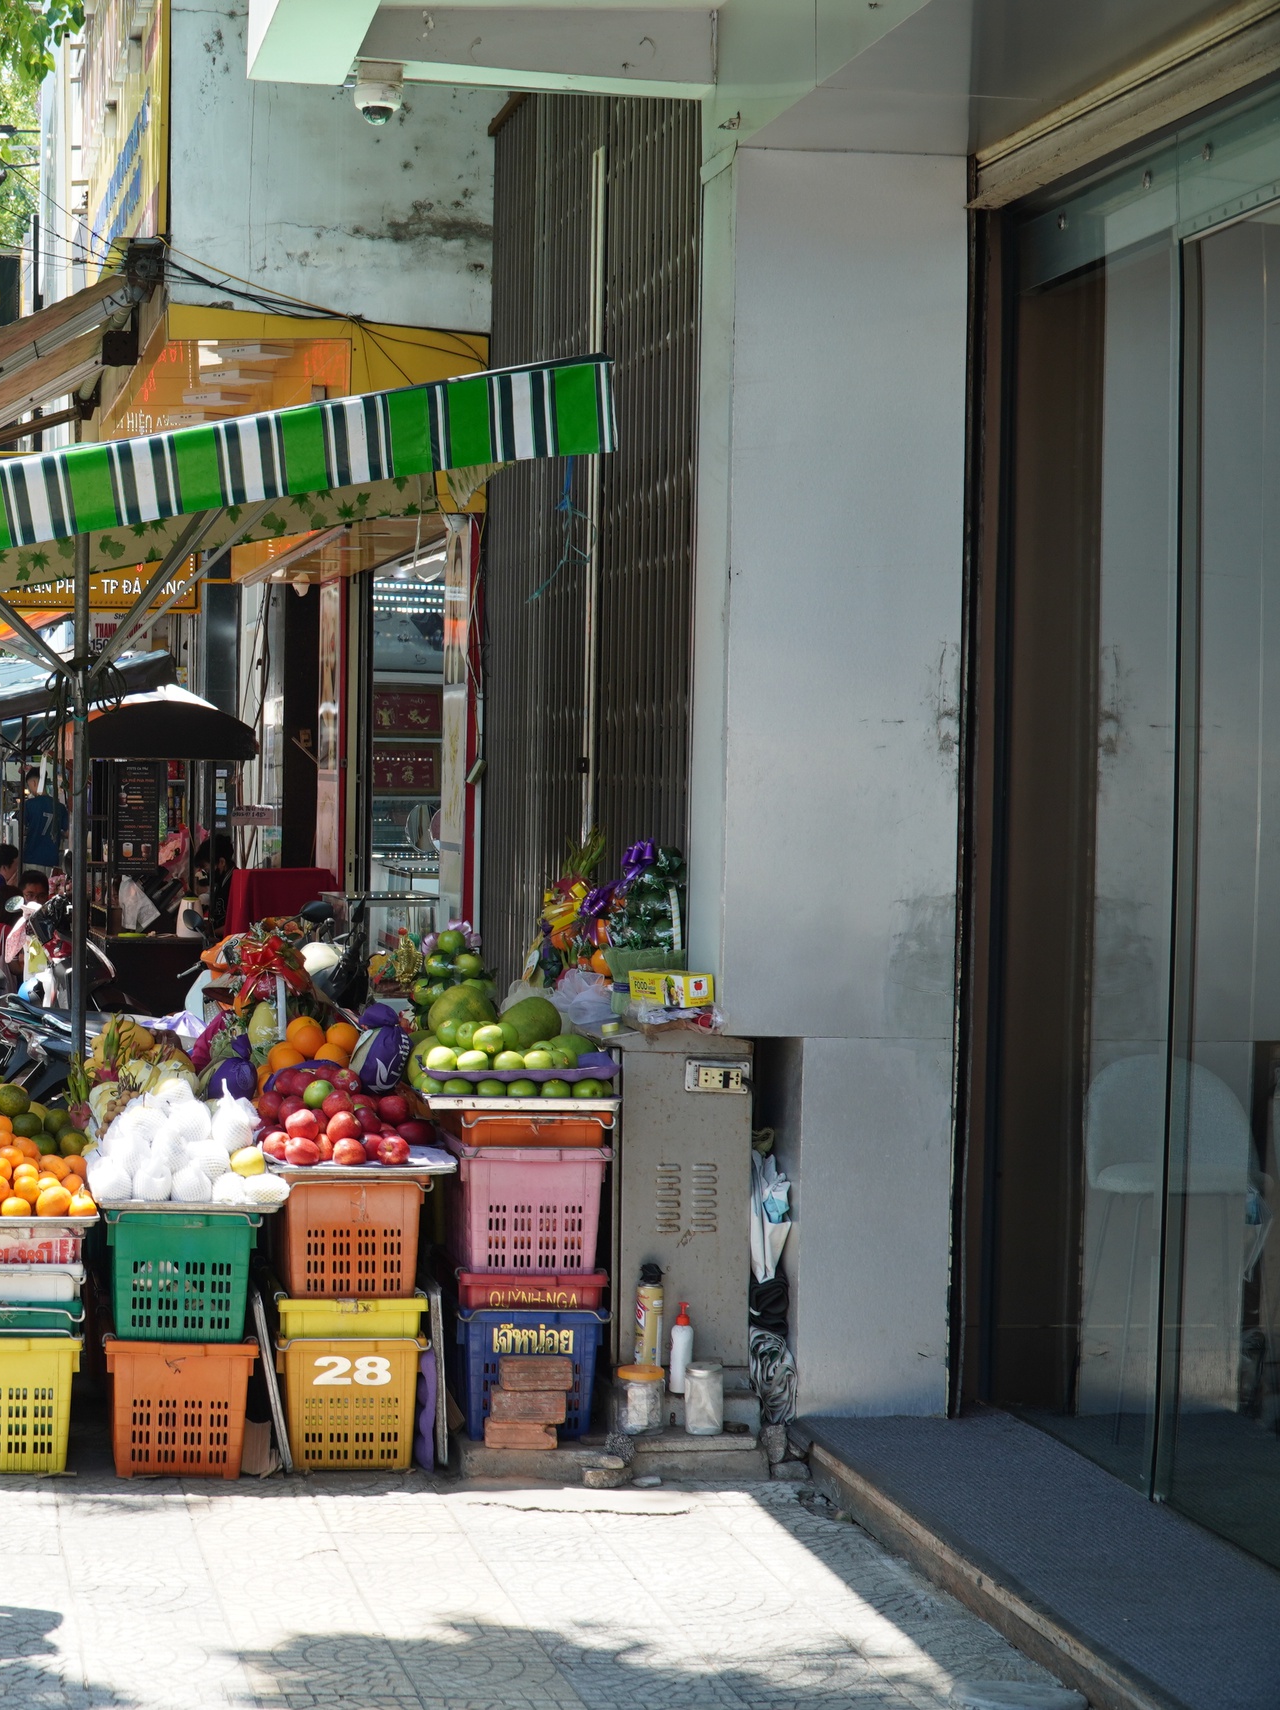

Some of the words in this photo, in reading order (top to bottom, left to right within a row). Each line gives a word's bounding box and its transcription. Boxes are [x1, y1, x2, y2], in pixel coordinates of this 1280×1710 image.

[100, 579, 119, 594] TP
[634, 980, 648, 990] FOOD
[312, 1355, 392, 1386] 28
